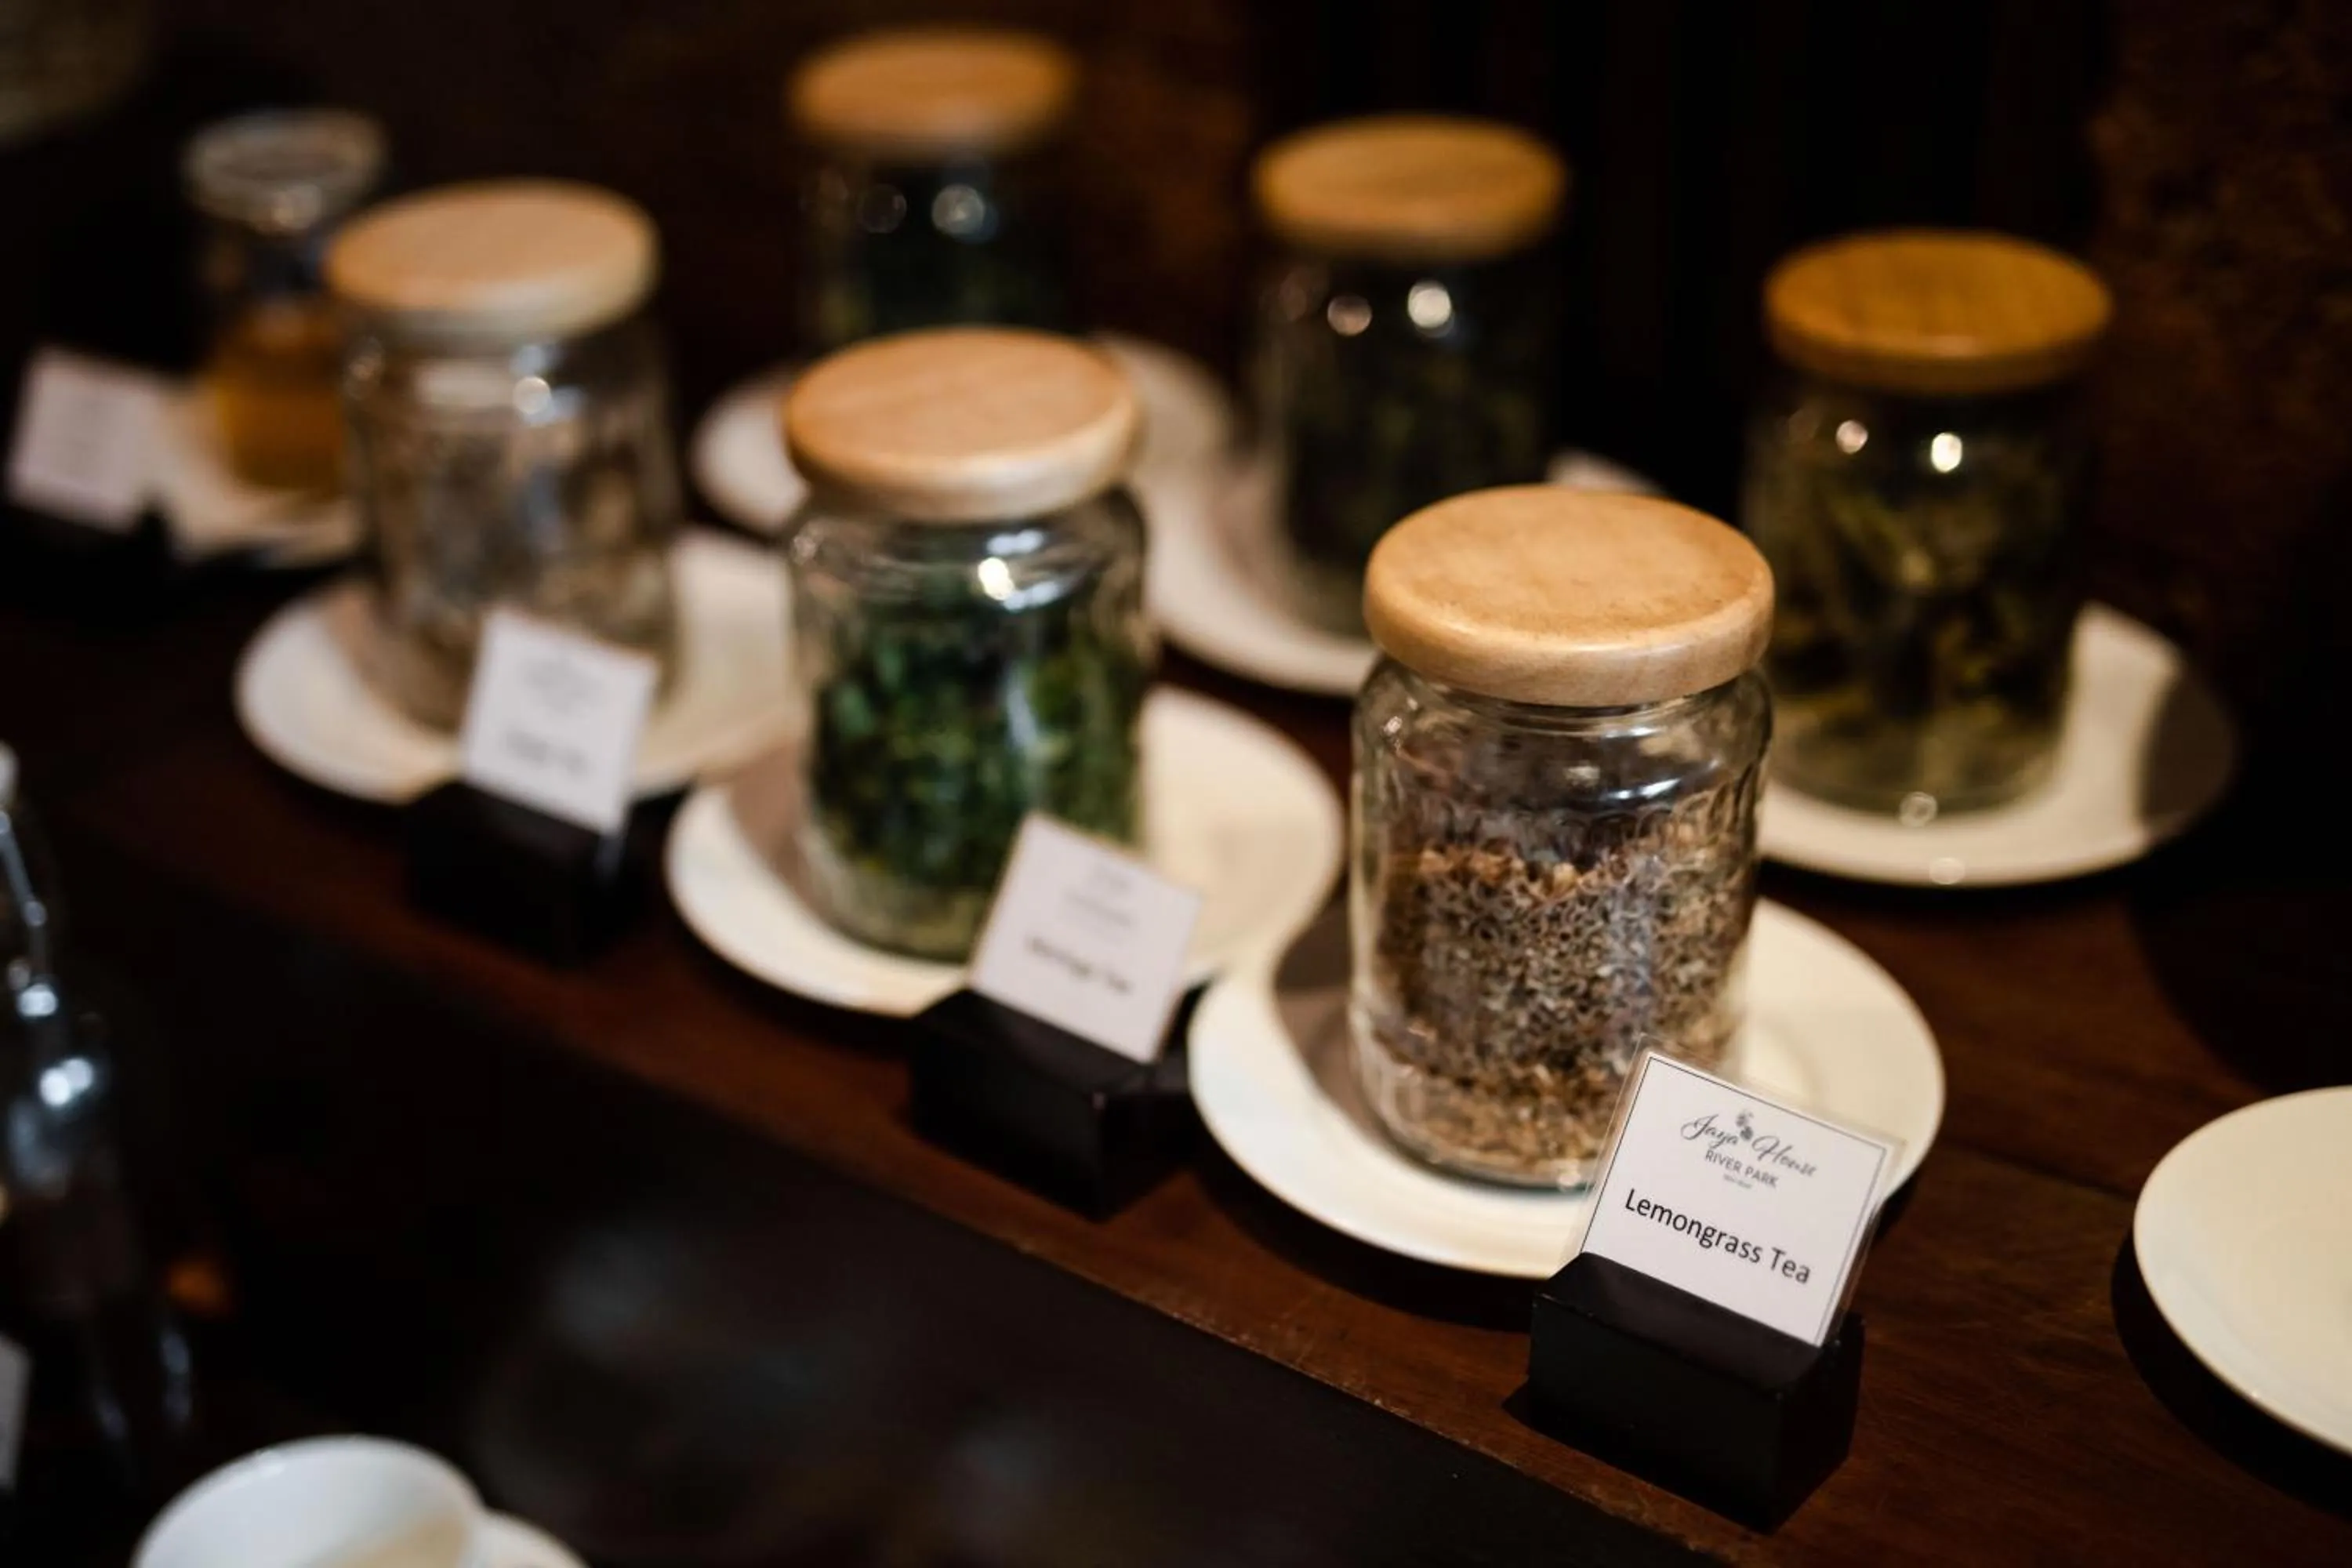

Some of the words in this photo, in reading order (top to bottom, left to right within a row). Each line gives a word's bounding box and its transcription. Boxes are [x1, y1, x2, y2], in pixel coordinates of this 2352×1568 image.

[1680, 1113, 1738, 1149] Jaya
[1751, 1135, 1817, 1177] House
[1705, 1149, 1743, 1174] RIVER
[1745, 1165, 1779, 1189] PARK
[1624, 1188, 1763, 1264] Lemongrass
[1771, 1247, 1811, 1284] Tea
